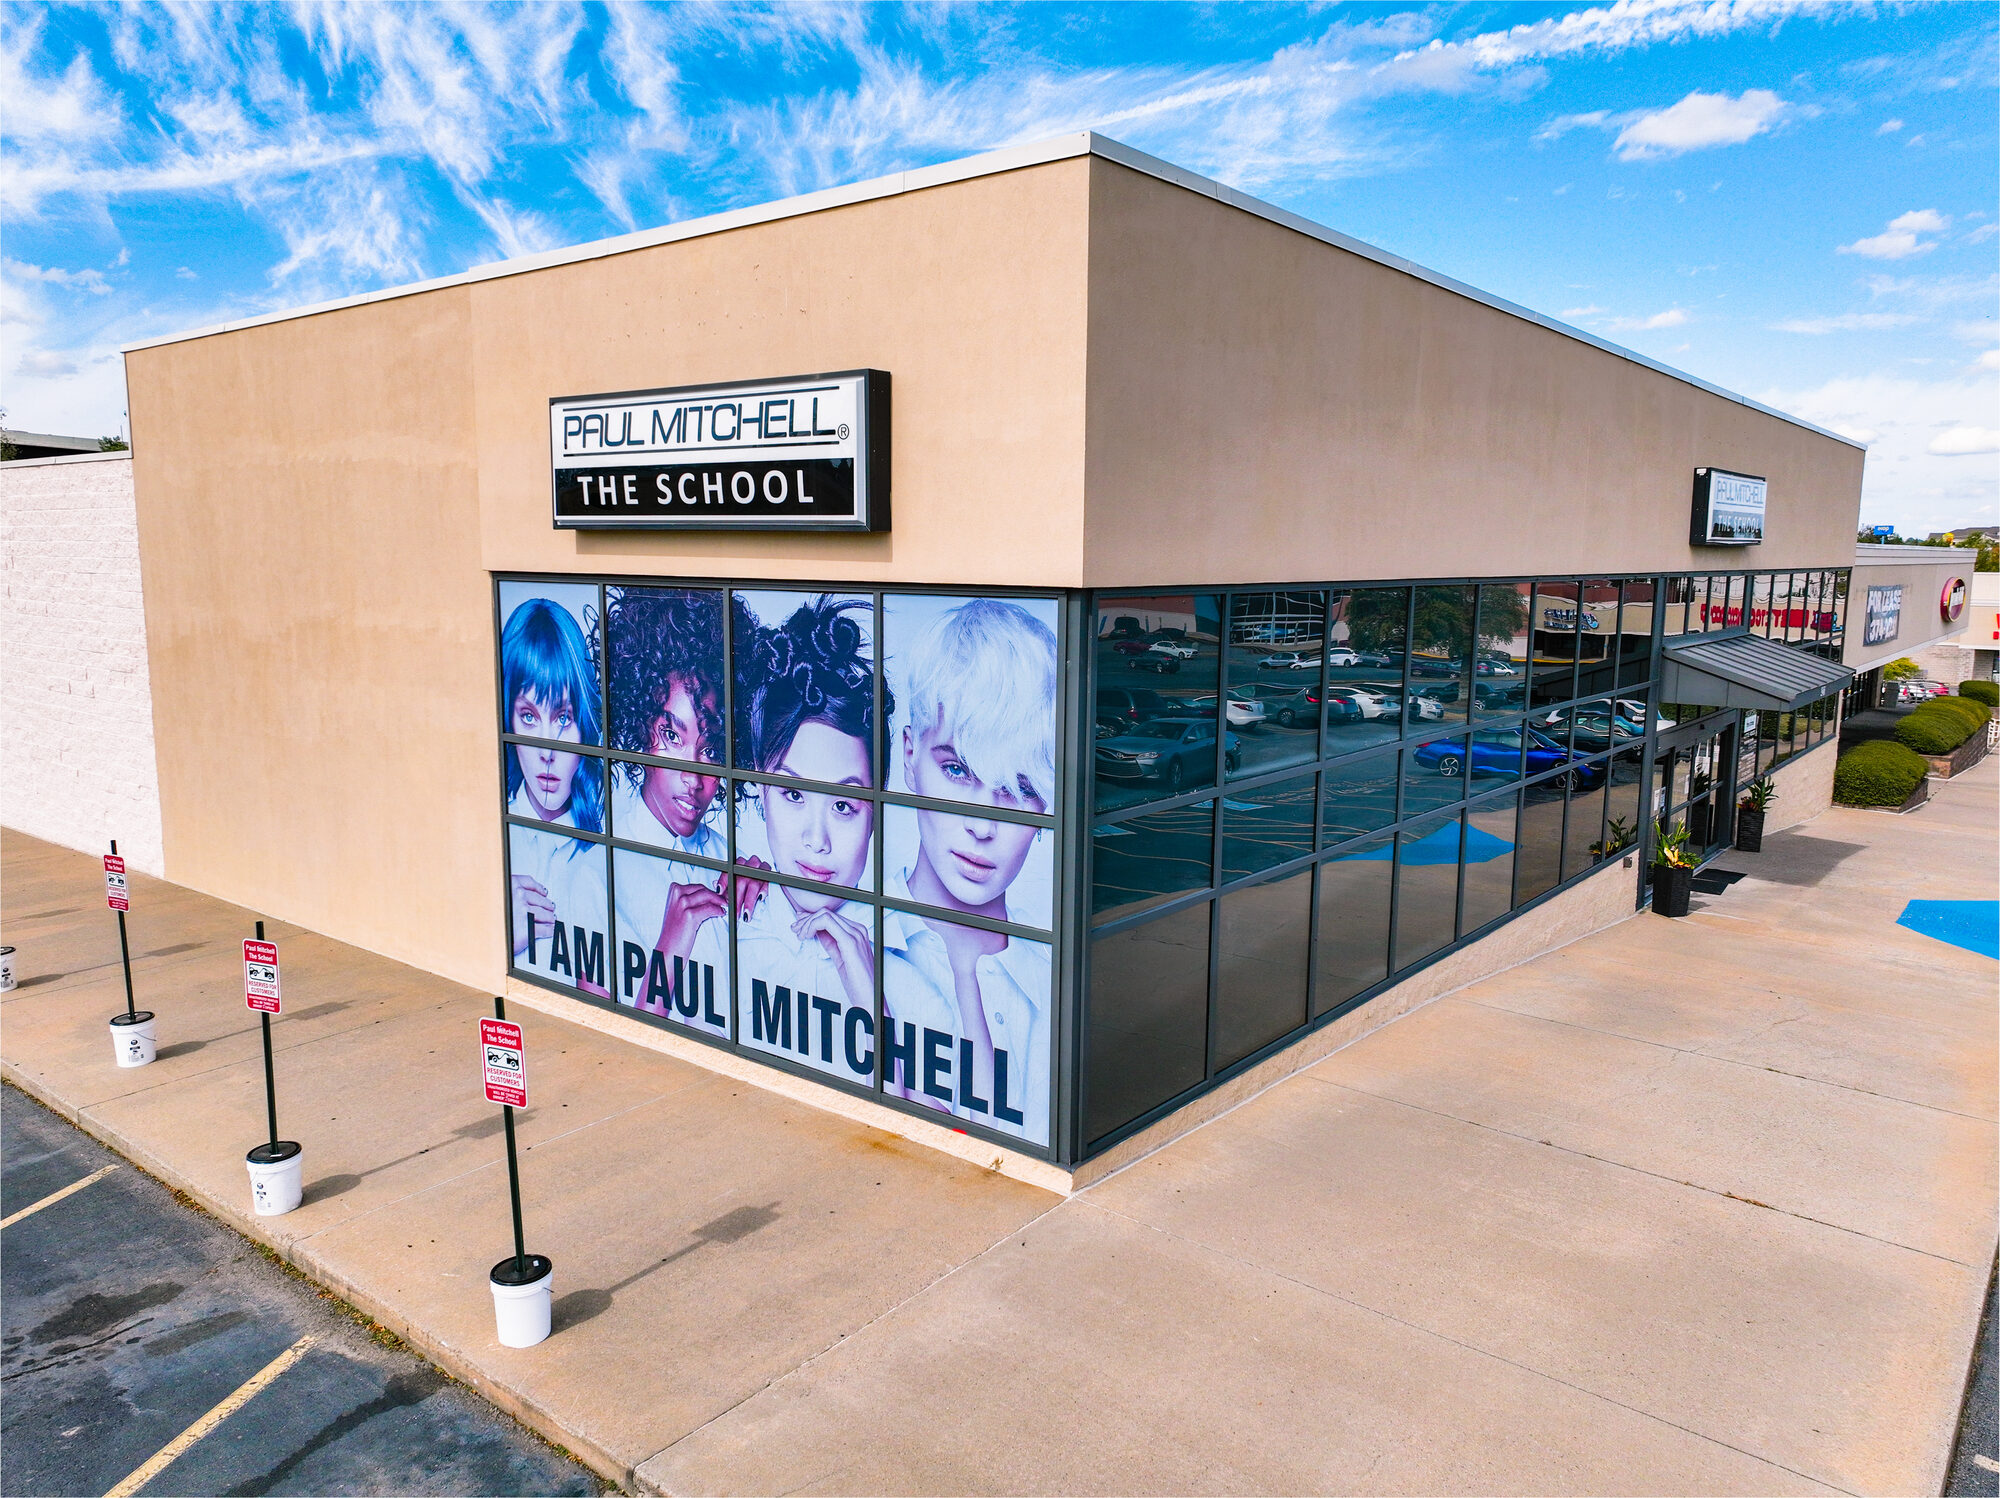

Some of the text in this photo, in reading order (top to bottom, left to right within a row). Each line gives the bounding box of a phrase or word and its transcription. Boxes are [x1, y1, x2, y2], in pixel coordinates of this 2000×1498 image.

[564, 411, 645, 450] PAUL
[577, 469, 814, 506] THE SCHOOL
[1718, 514, 1759, 535] THE SCHOOL
[1868, 590, 1902, 613] FOR LEASE
[245, 944, 275, 955] Paul Mitchell
[248, 952, 274, 962] The School
[527, 912, 1024, 1126] I AM PAUL MITCHELL
[482, 1023, 520, 1038] Paul Mitchell
[486, 1034, 517, 1046] The School
[487, 1067, 522, 1080] RESERVED FOR
[489, 1075, 521, 1087] CUSTOMERS
